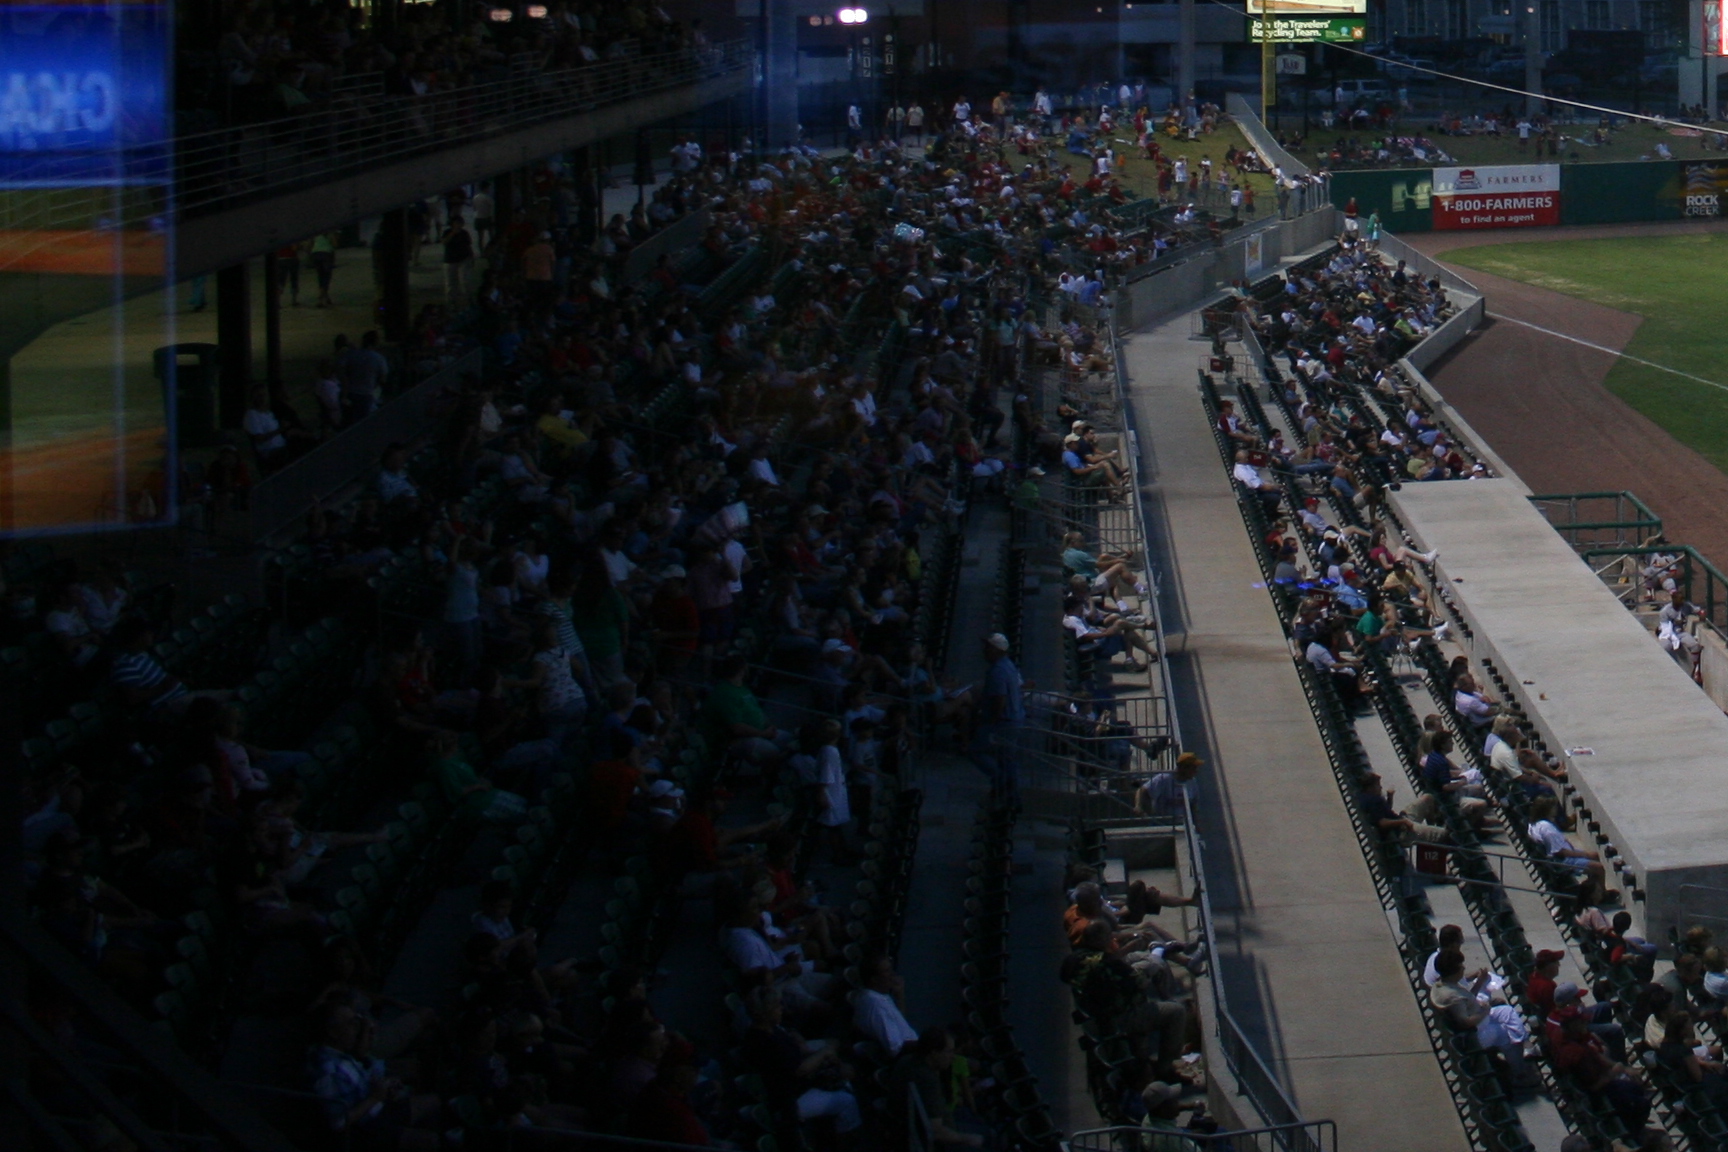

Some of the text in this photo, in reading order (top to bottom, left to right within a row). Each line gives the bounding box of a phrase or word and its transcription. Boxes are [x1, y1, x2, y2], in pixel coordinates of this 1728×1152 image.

[1487, 175, 1543, 184] FARMERS
[1442, 197, 1553, 212] 1-800-FARMERS
[1686, 195, 1718, 206] ROCK
[1685, 206, 1719, 216] CREEK
[1461, 216, 1470, 224] to
[1473, 215, 1492, 224] find
[1508, 214, 1534, 224] agent
